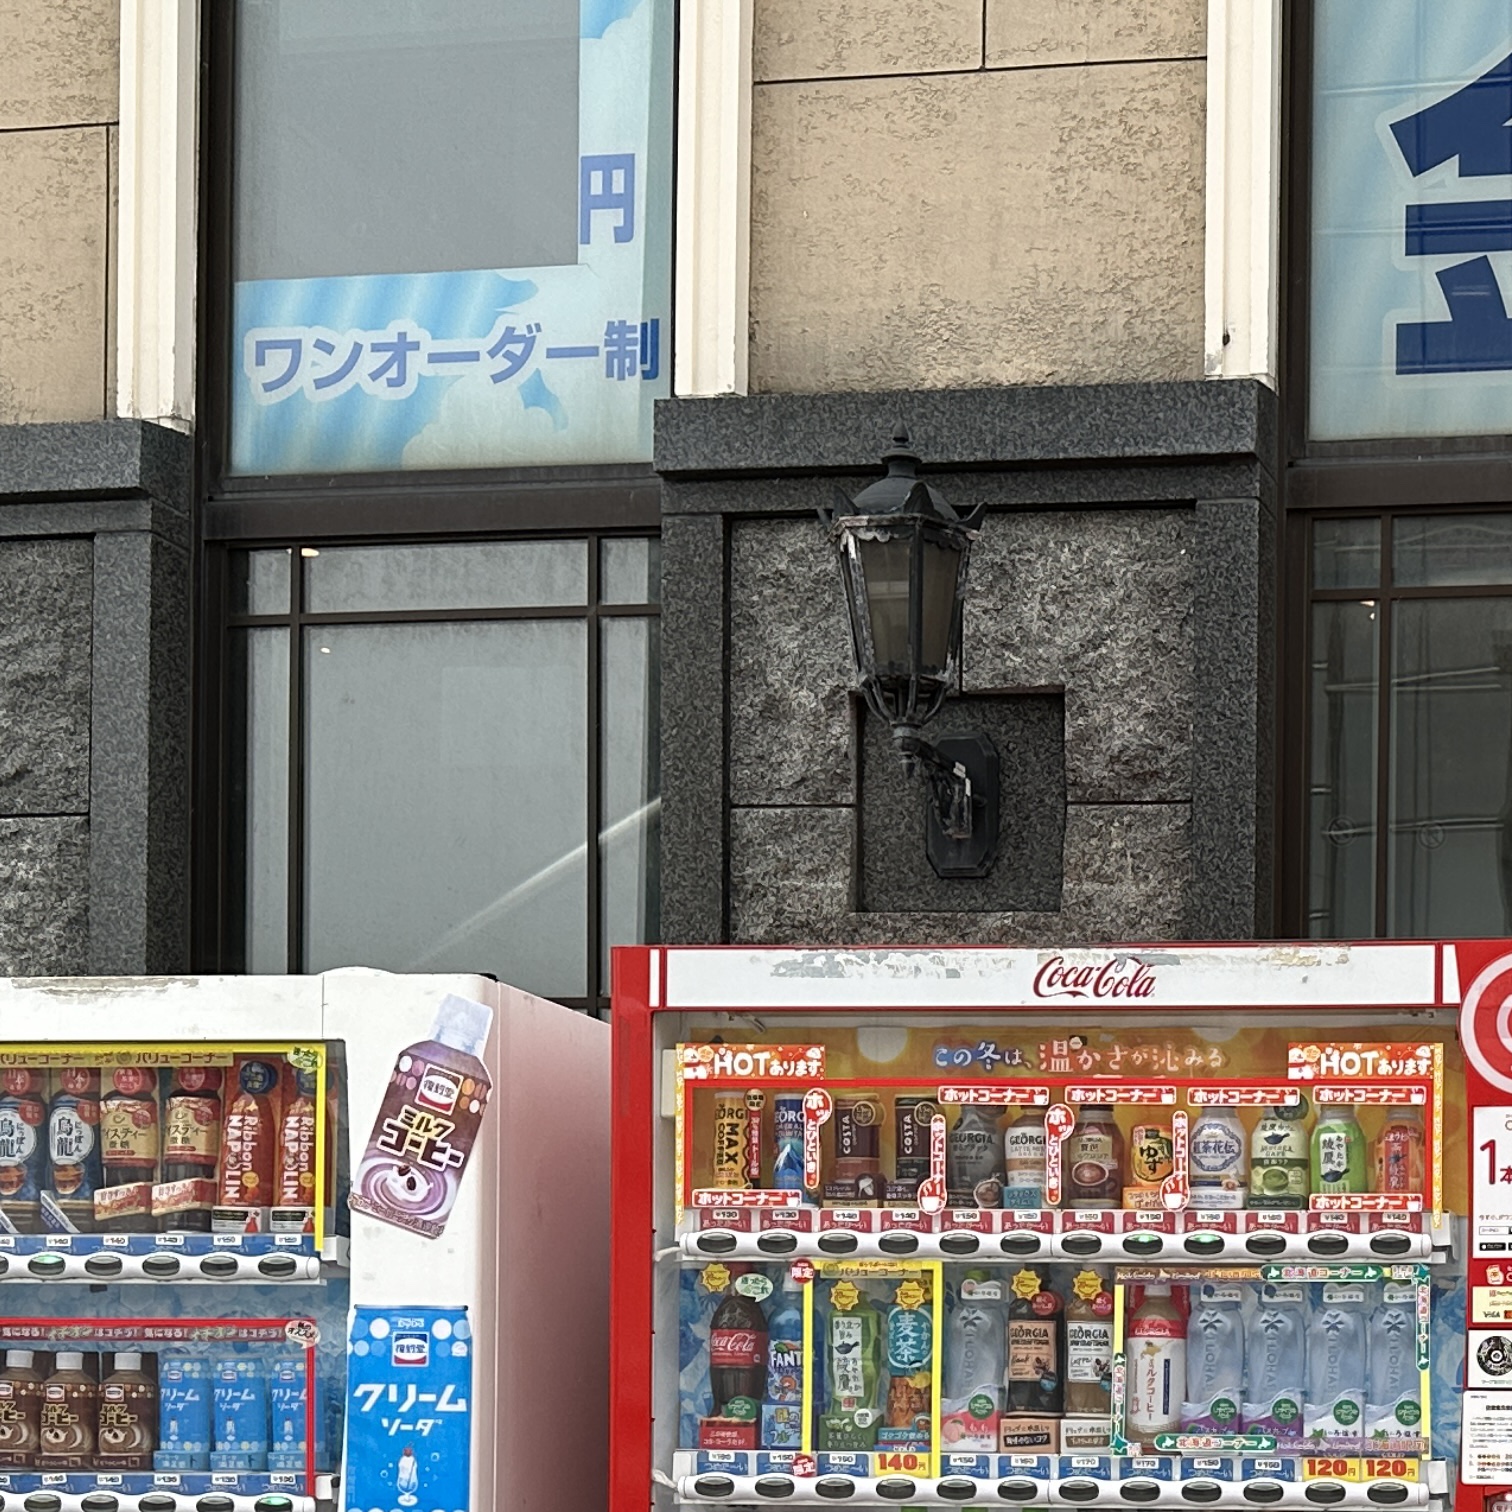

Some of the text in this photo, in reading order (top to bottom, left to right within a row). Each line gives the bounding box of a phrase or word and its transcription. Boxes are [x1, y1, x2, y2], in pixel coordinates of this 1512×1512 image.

[579, 152, 636, 246] 円
[252, 317, 660, 394] ワンオーダー制
[1033, 956, 1157, 999] Coca-Cola
[934, 1040, 1226, 1074] この冬は、温かさが沁みる
[944, 1089, 1028, 1102] ホットコーナー
[1071, 1089, 1157, 1102] ホットコーナー
[1193, 1089, 1280, 1103] ホットコーナー
[1319, 1089, 1405, 1102] ホットコーナー
[400, 1107, 454, 1142] ミルク
[842, 1114, 852, 1154] COSTA
[903, 1114, 913, 1153] COSTA
[242, 1115, 258, 1171] Ribbon
[299, 1115, 315, 1172] Ribbon
[380, 1120, 463, 1169] コーヒー
[724, 1122, 739, 1165] MAX
[697, 1192, 783, 1205] ホットコーナー
[1315, 1196, 1403, 1209] ホットコーナー
[1281, 1268, 1364, 1279] 北海道コーナー
[895, 1313, 919, 1361] 麦茶
[1010, 1325, 1049, 1338] GEORGIA
[1068, 1326, 1109, 1340] GEORGIA
[771, 1349, 803, 1368] FANT
[213, 1387, 256, 1402] クリーム
[353, 1383, 467, 1413] クリーム
[1146, 1360, 1156, 1421] ミルクコーヒー
[381, 1418, 443, 1437] ソーダ
[1177, 1438, 1258, 1449] 北海道コーナー
[877, 1454, 926, 1471] 140円
[1307, 1458, 1356, 1477] 120円
[1366, 1459, 1416, 1477] 120円
